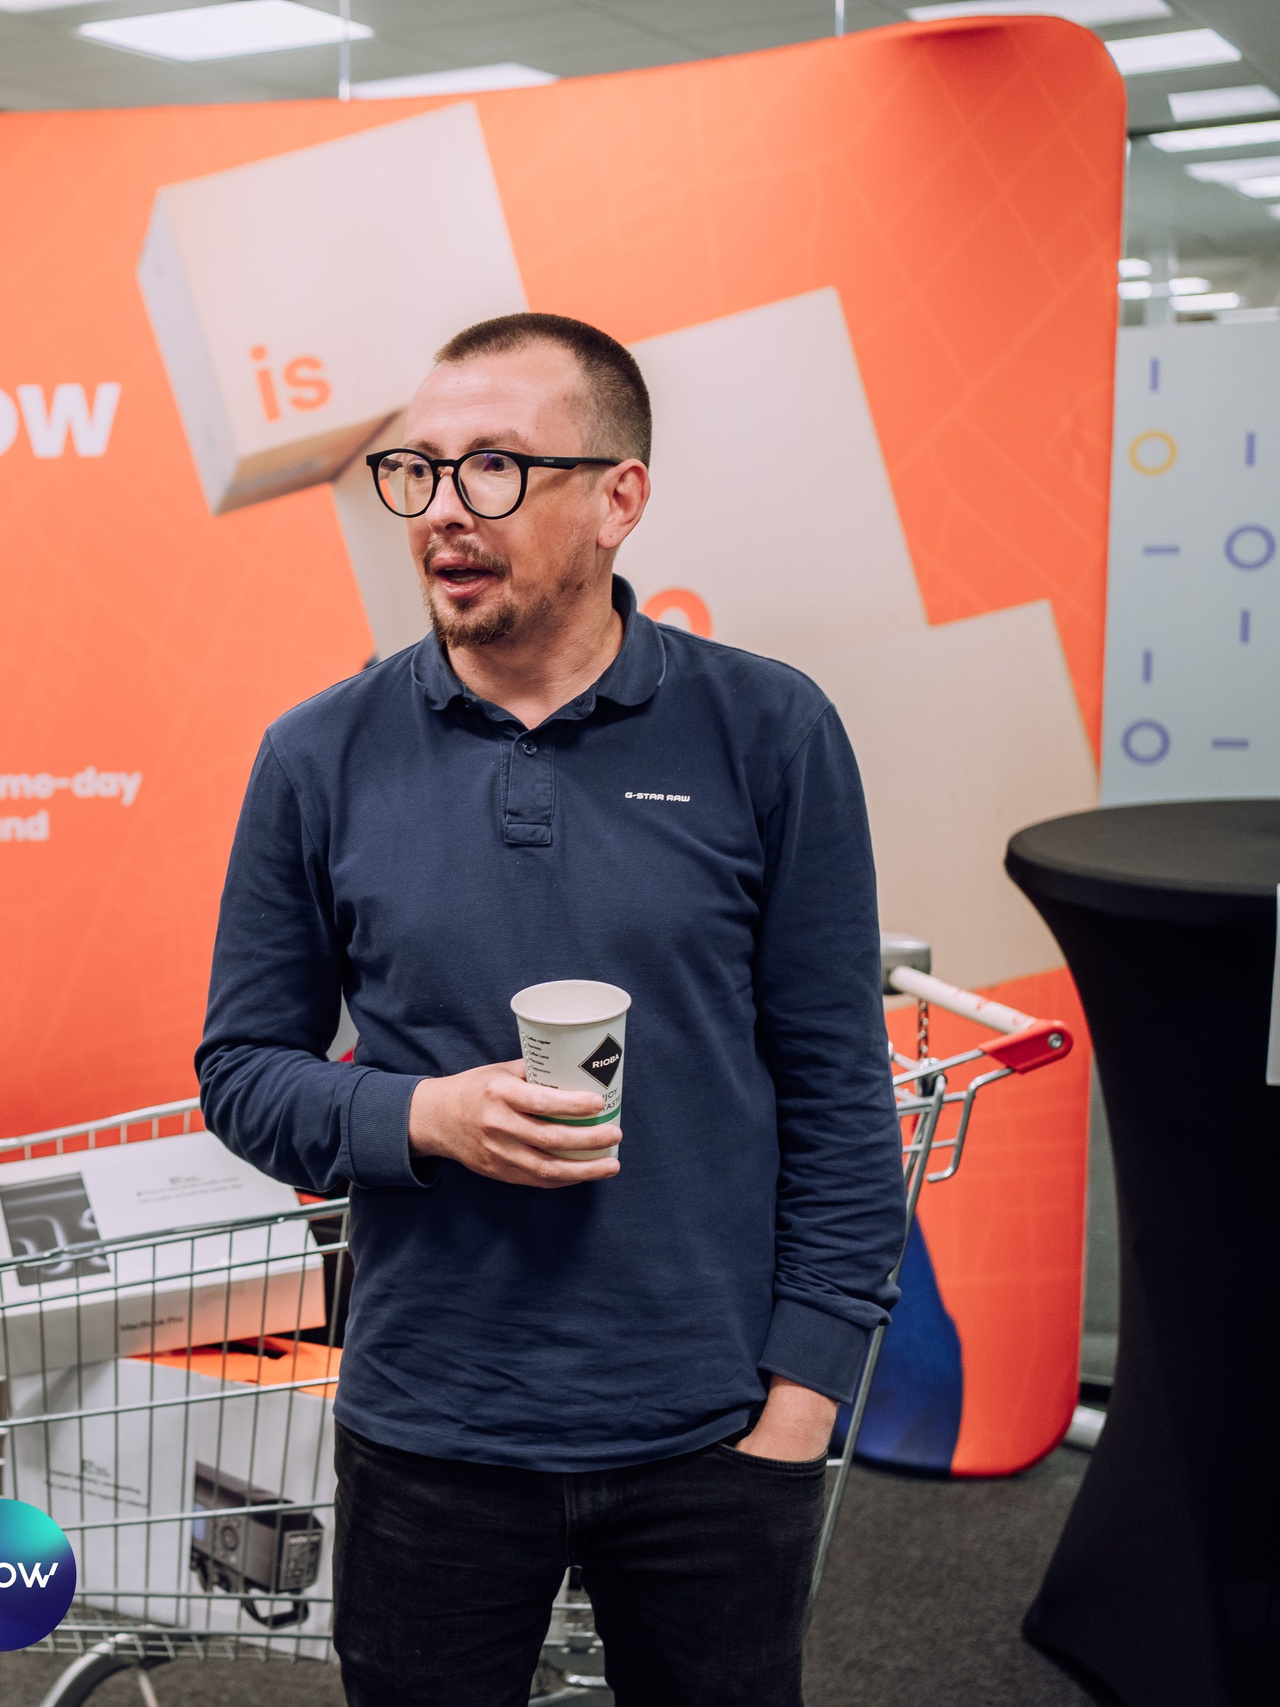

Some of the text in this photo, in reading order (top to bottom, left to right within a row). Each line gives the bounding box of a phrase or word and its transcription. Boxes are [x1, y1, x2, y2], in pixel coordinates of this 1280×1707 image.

[250, 344, 332, 422] is
[624, 791, 691, 803] G-STAR RAW
[592, 1053, 620, 1069] RIOBA
[602, 1087, 618, 1103] JOY
